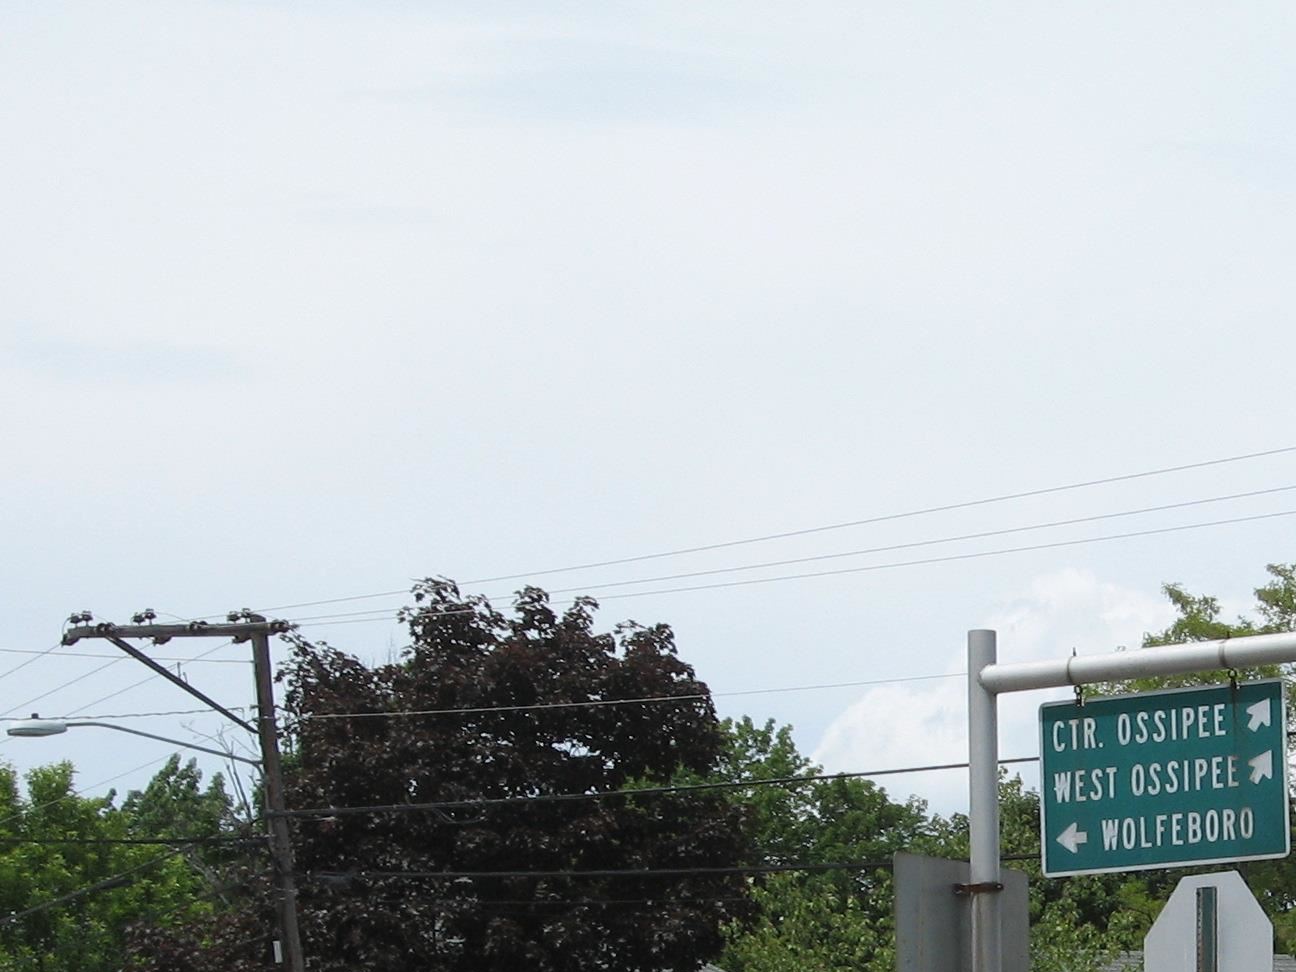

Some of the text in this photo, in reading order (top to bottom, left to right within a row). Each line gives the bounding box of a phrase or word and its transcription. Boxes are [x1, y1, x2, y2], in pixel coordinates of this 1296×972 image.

[1053, 703, 1226, 752] CTR. OSSIPEE
[1054, 755, 1240, 803] WEST OSSIPEE
[1101, 807, 1254, 851] WOLFEBORO
